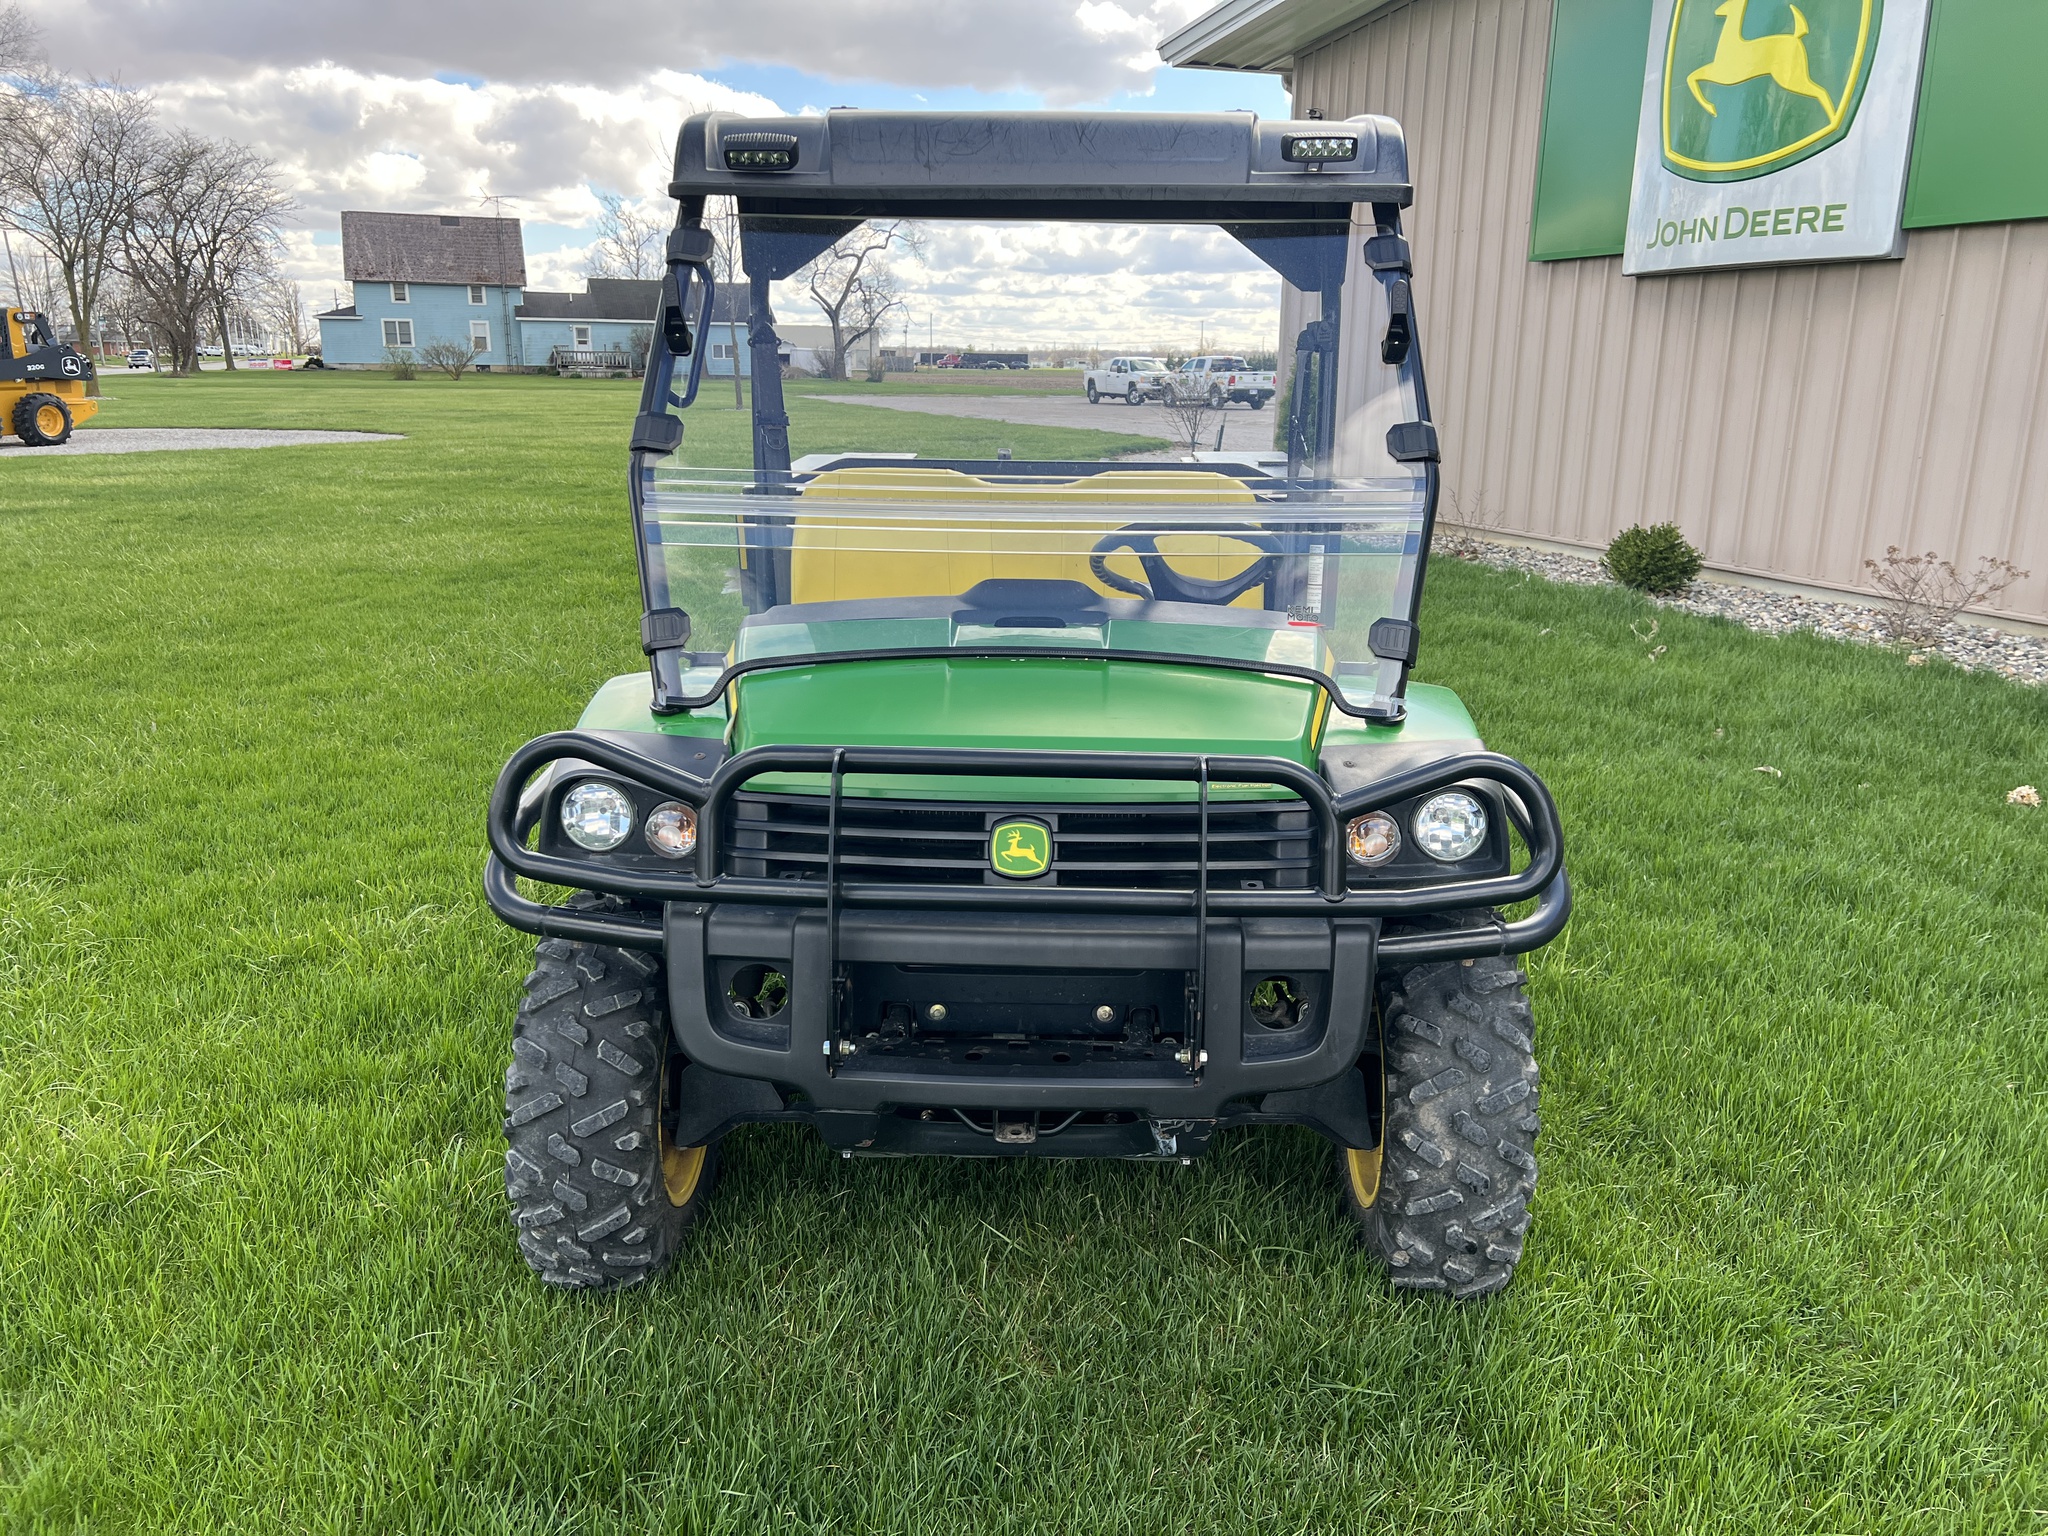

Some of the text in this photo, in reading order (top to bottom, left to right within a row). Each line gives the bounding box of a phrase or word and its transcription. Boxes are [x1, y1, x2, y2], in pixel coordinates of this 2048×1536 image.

[1646, 203, 1848, 250] JOHN DEERE
[1287, 613, 1319, 621] MOTO
